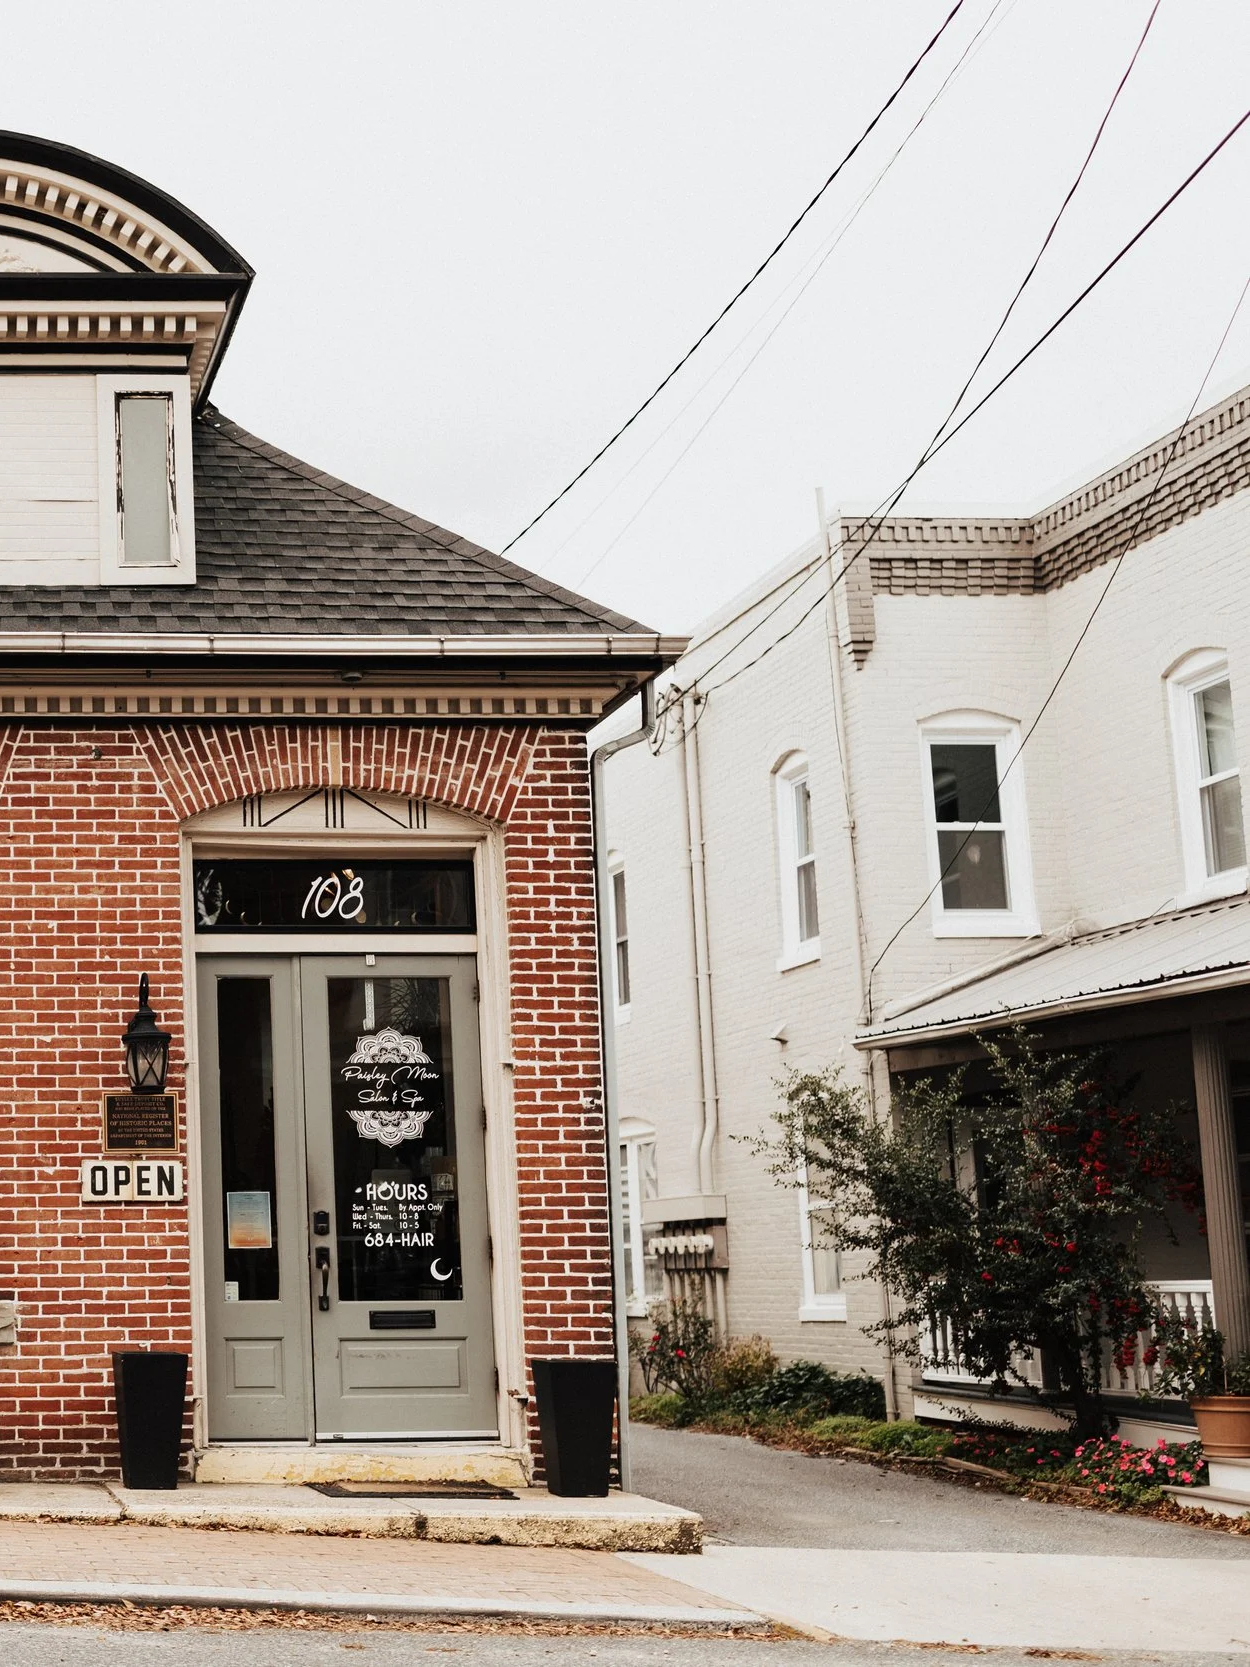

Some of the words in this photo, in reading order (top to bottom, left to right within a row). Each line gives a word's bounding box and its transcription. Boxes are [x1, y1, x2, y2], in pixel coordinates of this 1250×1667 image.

[301, 876, 364, 919] 108
[341, 1066, 389, 1089] Paisley
[391, 1065, 439, 1084] Moon
[358, 1089, 389, 1103] Salon
[392, 1090, 397, 1105] &
[401, 1089, 424, 1108] Spa
[90, 1165, 175, 1196] OPEN
[366, 1183, 428, 1200] HOURS
[372, 1203, 388, 1211] Tues.
[427, 1203, 443, 1212] Only
[364, 1232, 434, 1247] 684-HAIR
